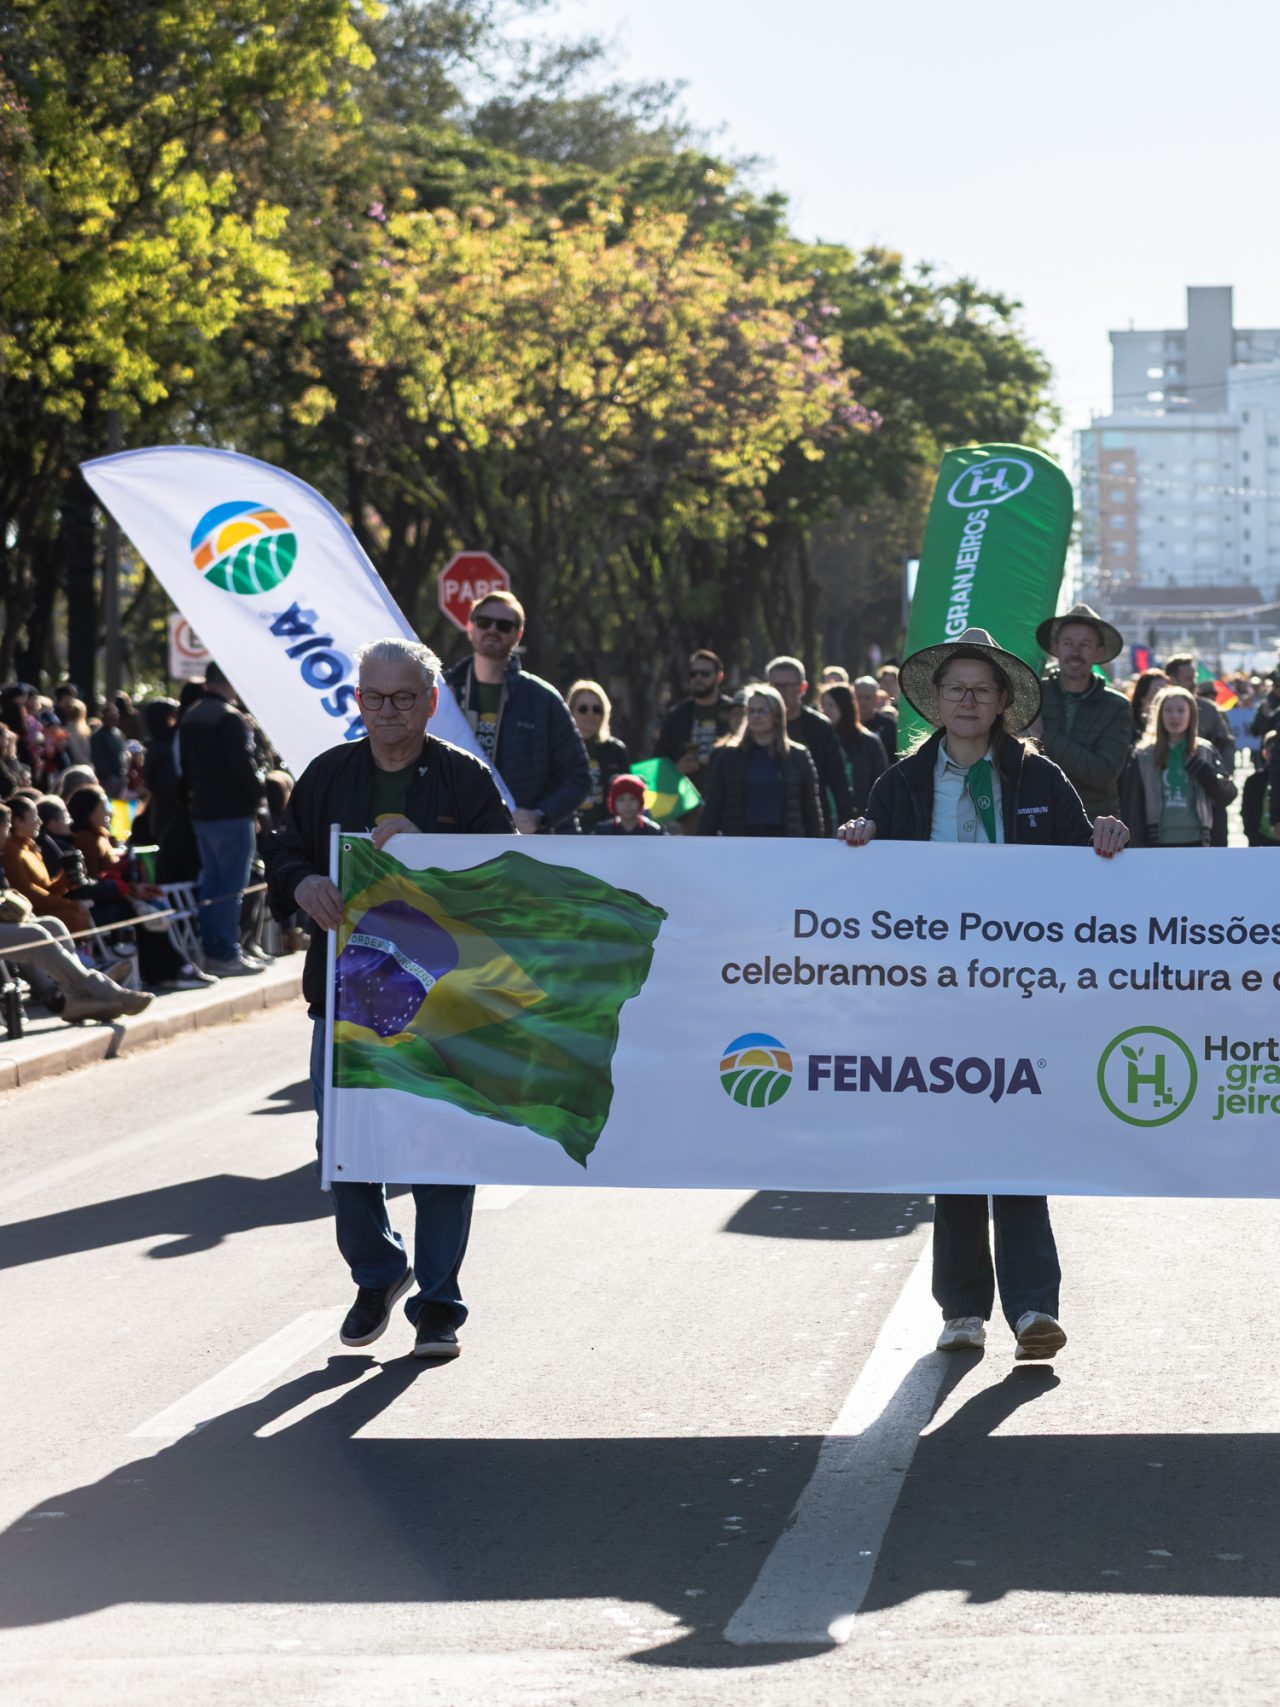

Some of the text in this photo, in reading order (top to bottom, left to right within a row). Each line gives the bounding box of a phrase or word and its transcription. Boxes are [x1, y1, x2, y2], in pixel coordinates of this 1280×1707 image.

[794, 909, 861, 939] Dos
[871, 910, 949, 940] Sete
[960, 912, 1064, 943] Povos
[1074, 915, 1137, 944] das
[721, 955, 928, 988] celebramos
[937, 965, 959, 988] a
[967, 958, 1067, 999] força,
[1077, 967, 1099, 989] a
[1108, 961, 1232, 991] cultura
[1241, 970, 1263, 992] e
